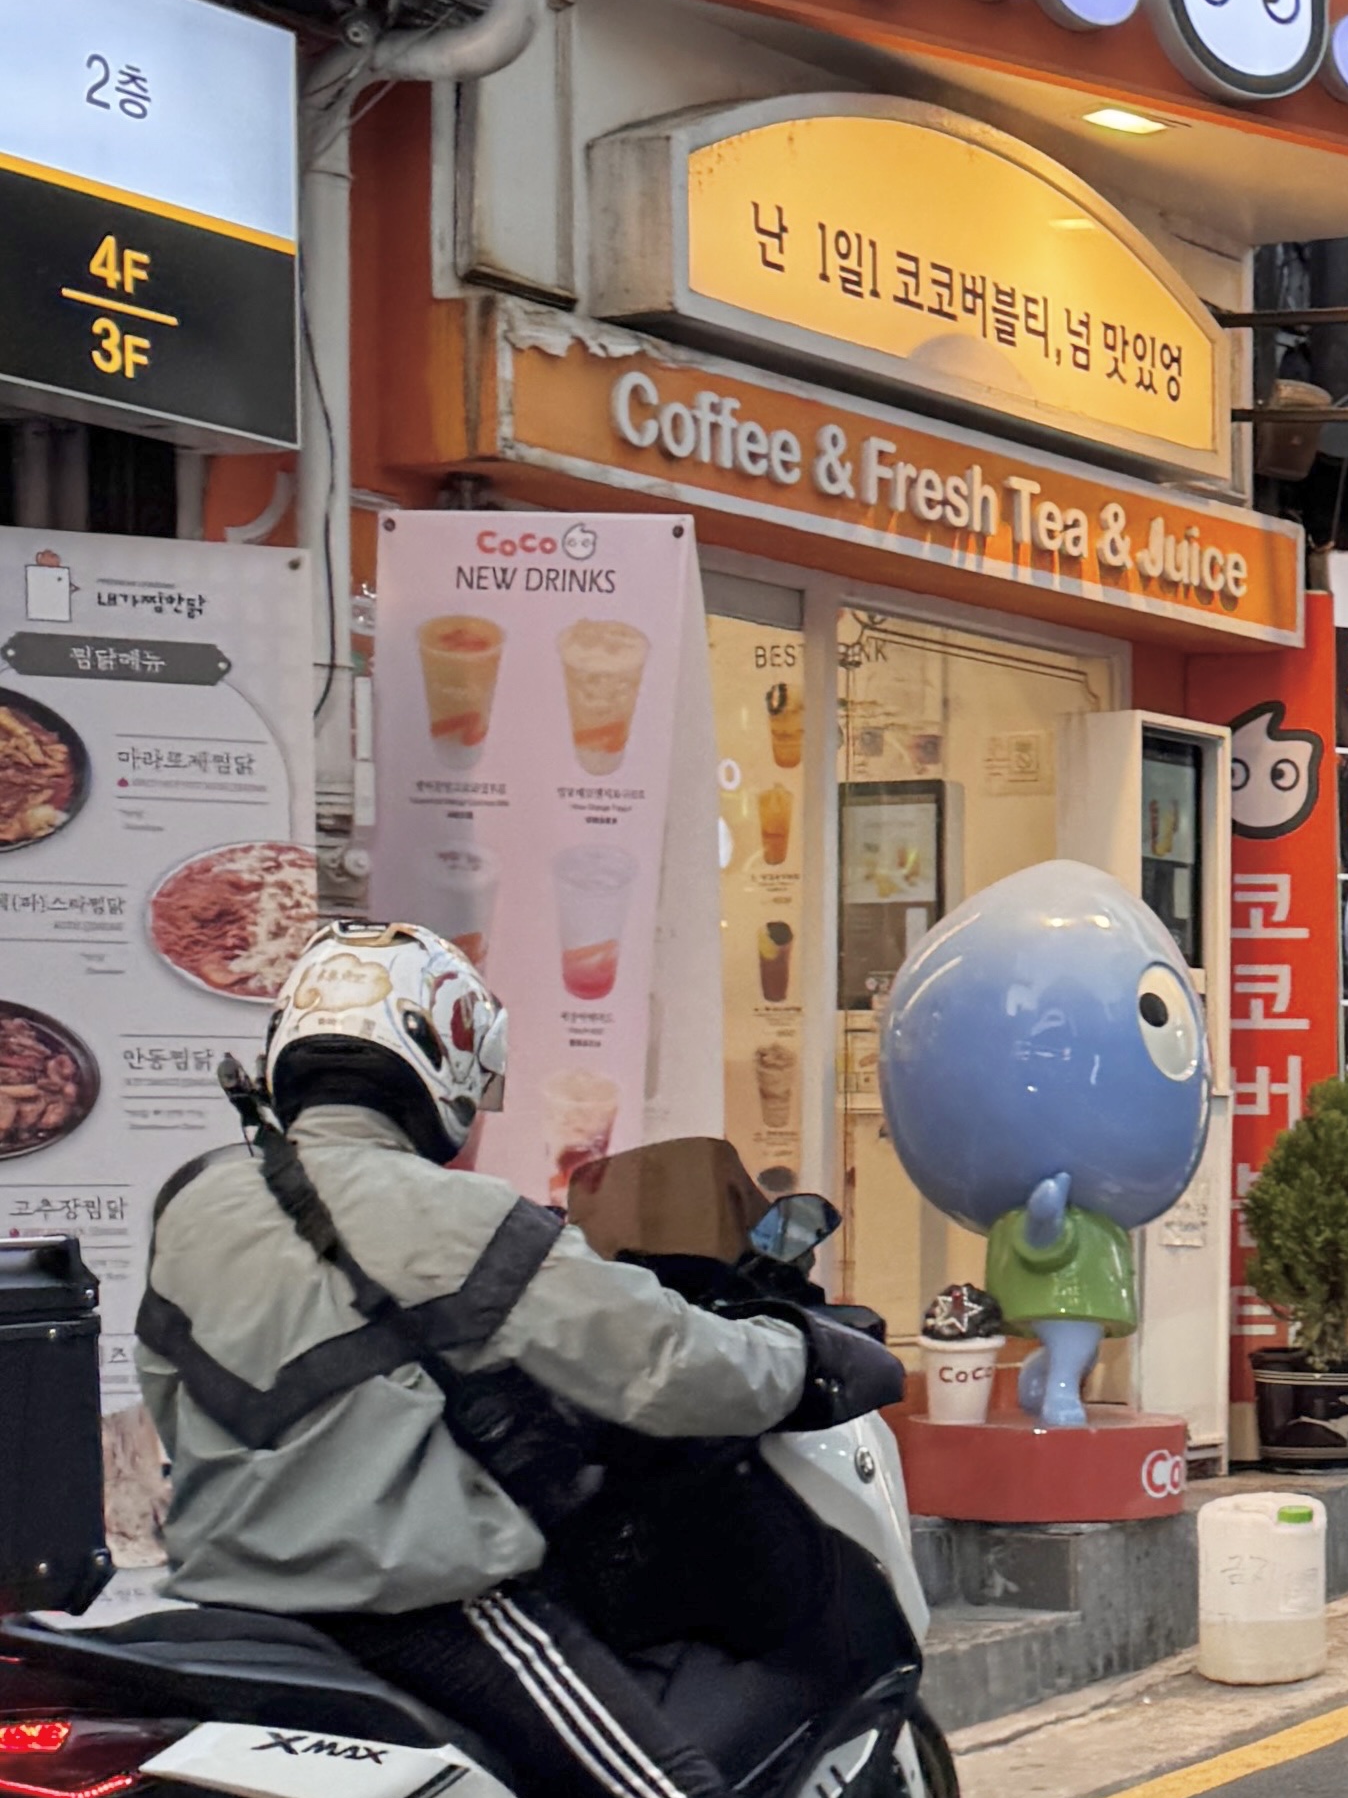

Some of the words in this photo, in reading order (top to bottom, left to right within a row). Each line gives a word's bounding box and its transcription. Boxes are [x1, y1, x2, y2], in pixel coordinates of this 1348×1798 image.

[85, 53, 152, 120] 2층
[88, 235, 152, 293] 4F
[751, 200, 789, 274] 난
[90, 317, 152, 379] 3F
[612, 370, 802, 486] Coffee
[815, 422, 855, 498] &
[862, 439, 999, 536] Fresh
[1006, 475, 1088, 565] Tea
[1098, 500, 1134, 566] &
[1137, 506, 1248, 599] Juice
[477, 530, 558, 557] CoCo
[456, 564, 519, 591] NEW
[526, 567, 617, 593] DRINKS
[251, 1732, 389, 1765] XMAX
